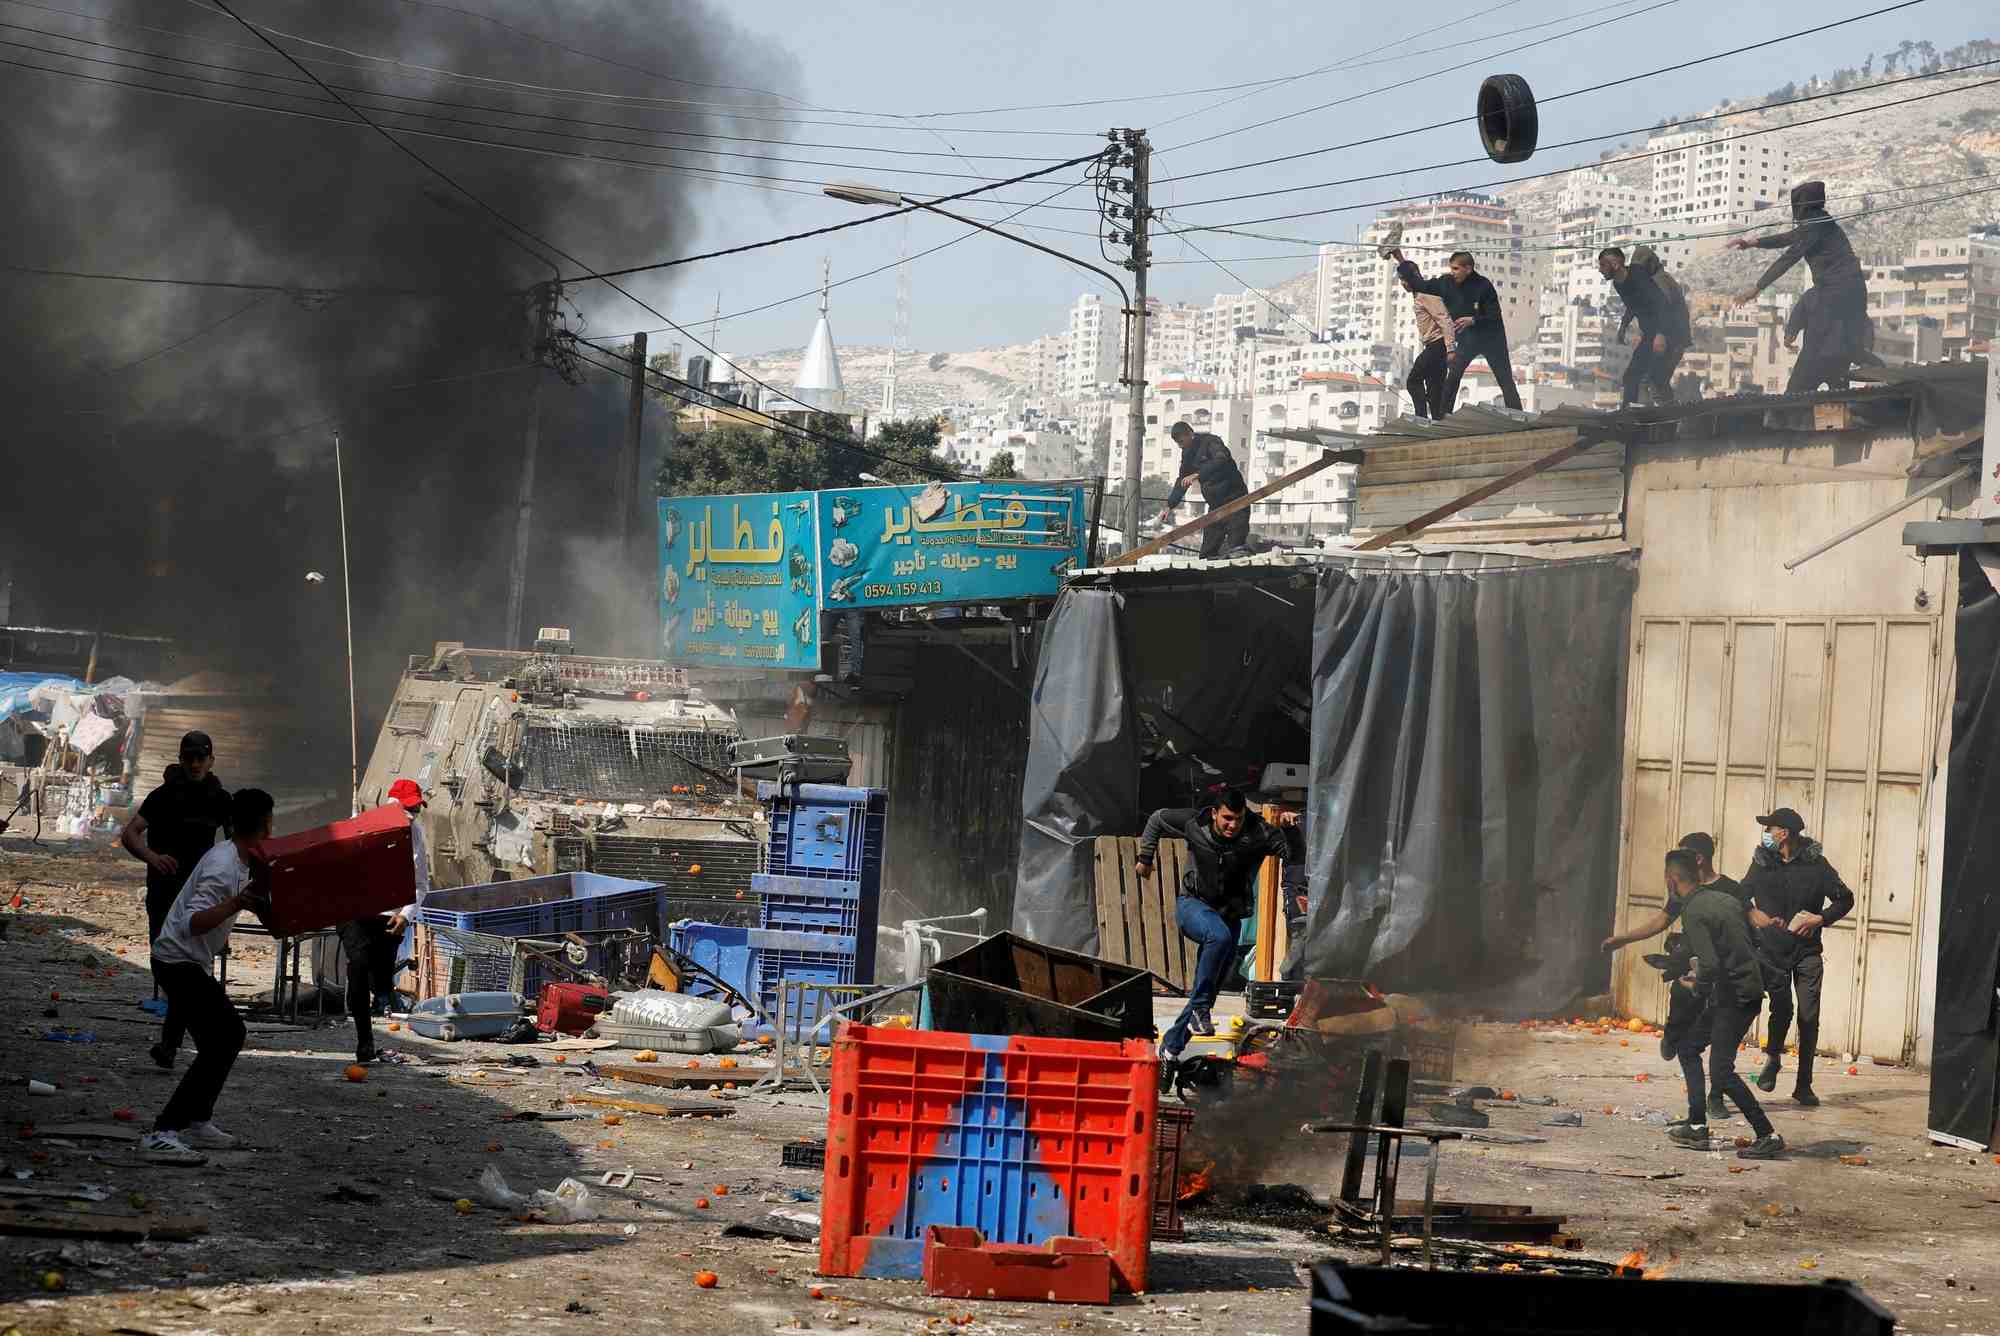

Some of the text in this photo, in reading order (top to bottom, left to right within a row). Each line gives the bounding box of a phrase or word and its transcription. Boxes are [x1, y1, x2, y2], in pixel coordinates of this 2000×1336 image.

[687, 501, 784, 581] فطاير
[892, 549, 926, 576] تأجير
[941, 552, 981, 573] صيانة
[995, 551, 1017, 570] بيع
[864, 580, 942, 599] 0594 159 413
[762, 608, 780, 636] بيع
